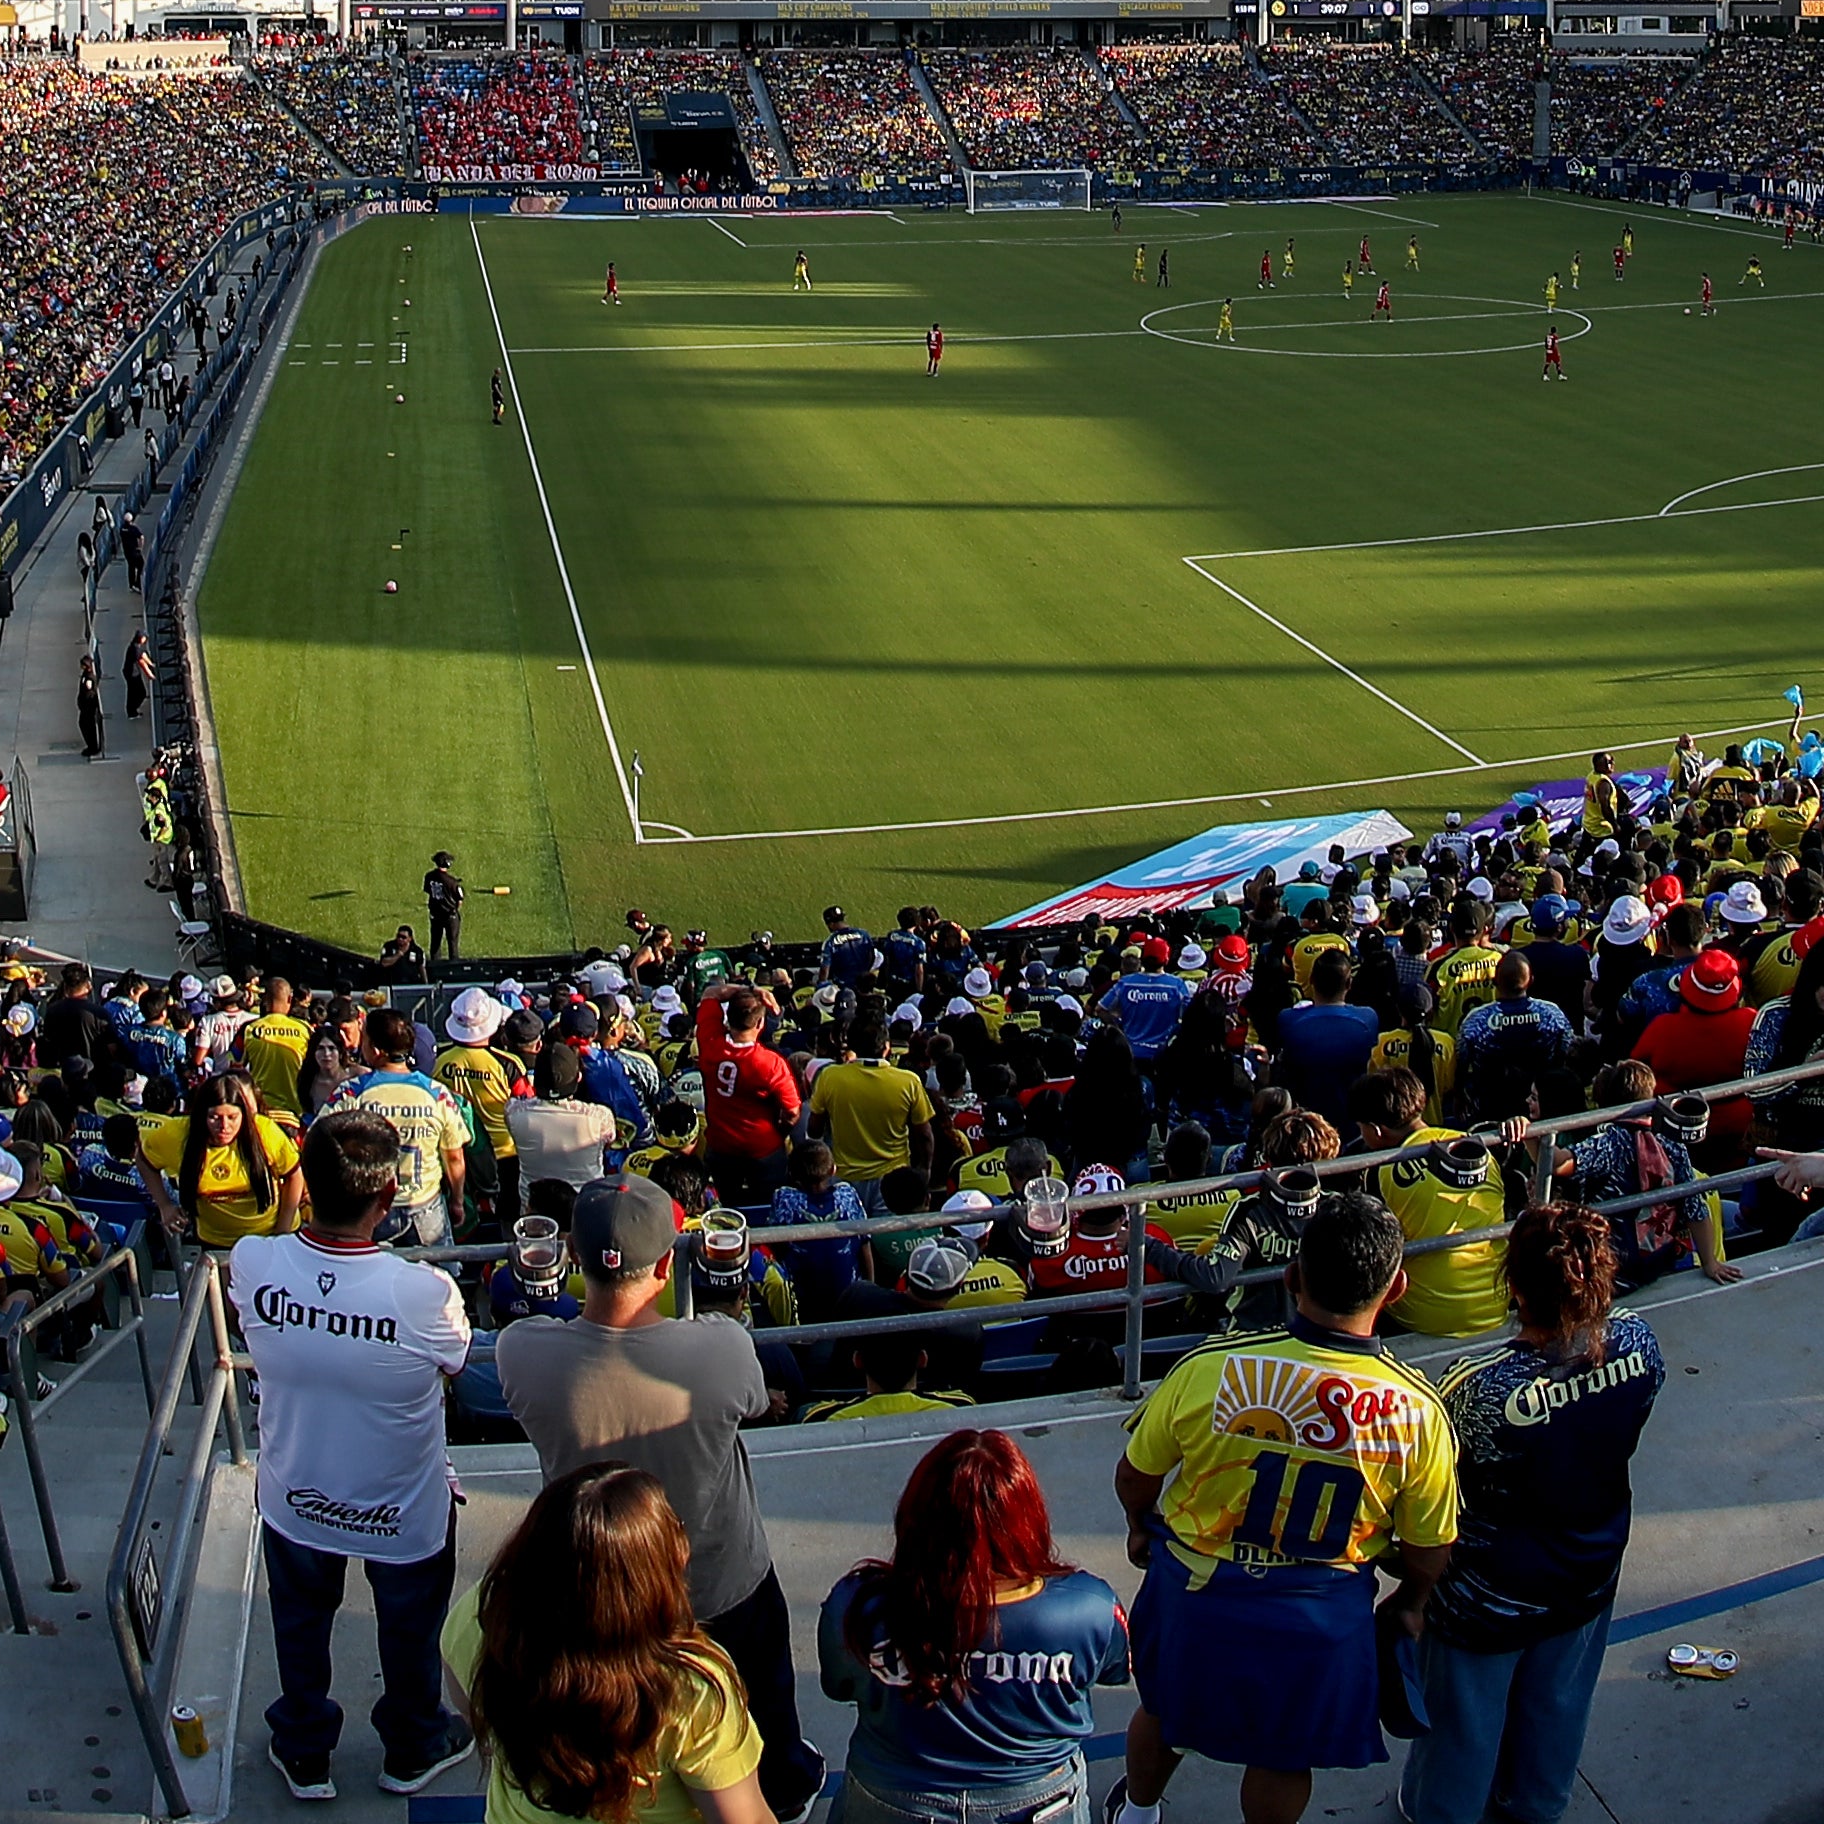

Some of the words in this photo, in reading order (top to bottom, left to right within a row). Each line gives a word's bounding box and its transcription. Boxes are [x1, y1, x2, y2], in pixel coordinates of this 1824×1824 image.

[1293, 4, 1298, 14] 1
[1369, 4, 1374, 14] 1
[385, 200, 398, 213] DEL
[624, 197, 635, 210] EL
[637, 197, 679, 210] TEQUILA
[680, 197, 718, 209] OFICIAL
[721, 196, 737, 208] DEL
[740, 193, 778, 208] FÚTBOL
[1127, 988, 1169, 1003] Corona
[251, 1025, 300, 1039] Corona
[1487, 1012, 1541, 1031] Corona
[442, 1061, 493, 1081] Corona
[717, 1060, 738, 1097] 9
[89, 1163, 137, 1186] Corona
[1156, 1189, 1228, 1213] Corona
[1287, 1206, 1304, 1216] WC
[1034, 1244, 1051, 1255] WC
[1065, 1253, 1129, 1280] Coron
[526, 1286, 544, 1296] WC
[709, 1275, 728, 1286] WC
[254, 1284, 399, 1344] Corona
[1505, 1351, 1646, 1426] Corona
[286, 1487, 401, 1524] Caliente
[1231, 1449, 1366, 1561] 10
[295, 1508, 401, 1537] caliente.mx
[141, 1556, 158, 1626] 124
[869, 1646, 1074, 1687] Crona
